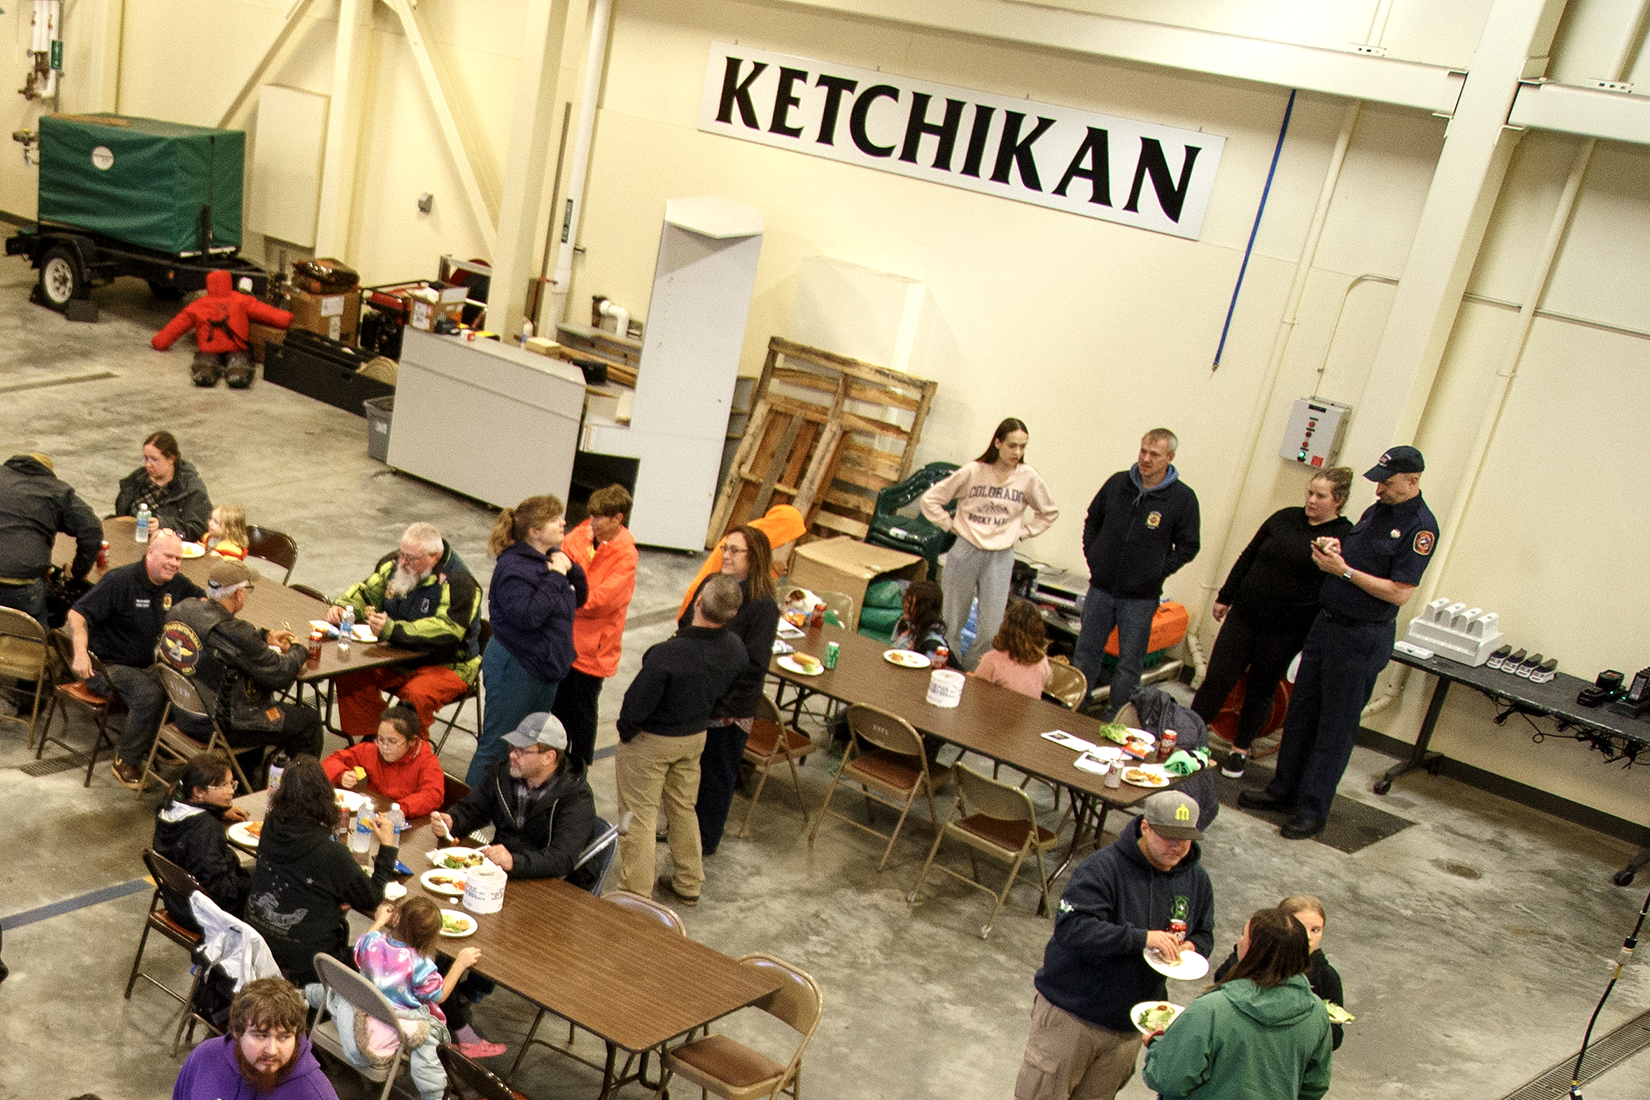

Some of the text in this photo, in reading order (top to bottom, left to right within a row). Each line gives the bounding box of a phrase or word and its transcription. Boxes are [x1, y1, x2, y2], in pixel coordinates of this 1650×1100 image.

[715, 55, 1203, 225] KETCHIKAN
[968, 484, 1024, 503] COLORADO
[968, 513, 992, 526] ROCKY
